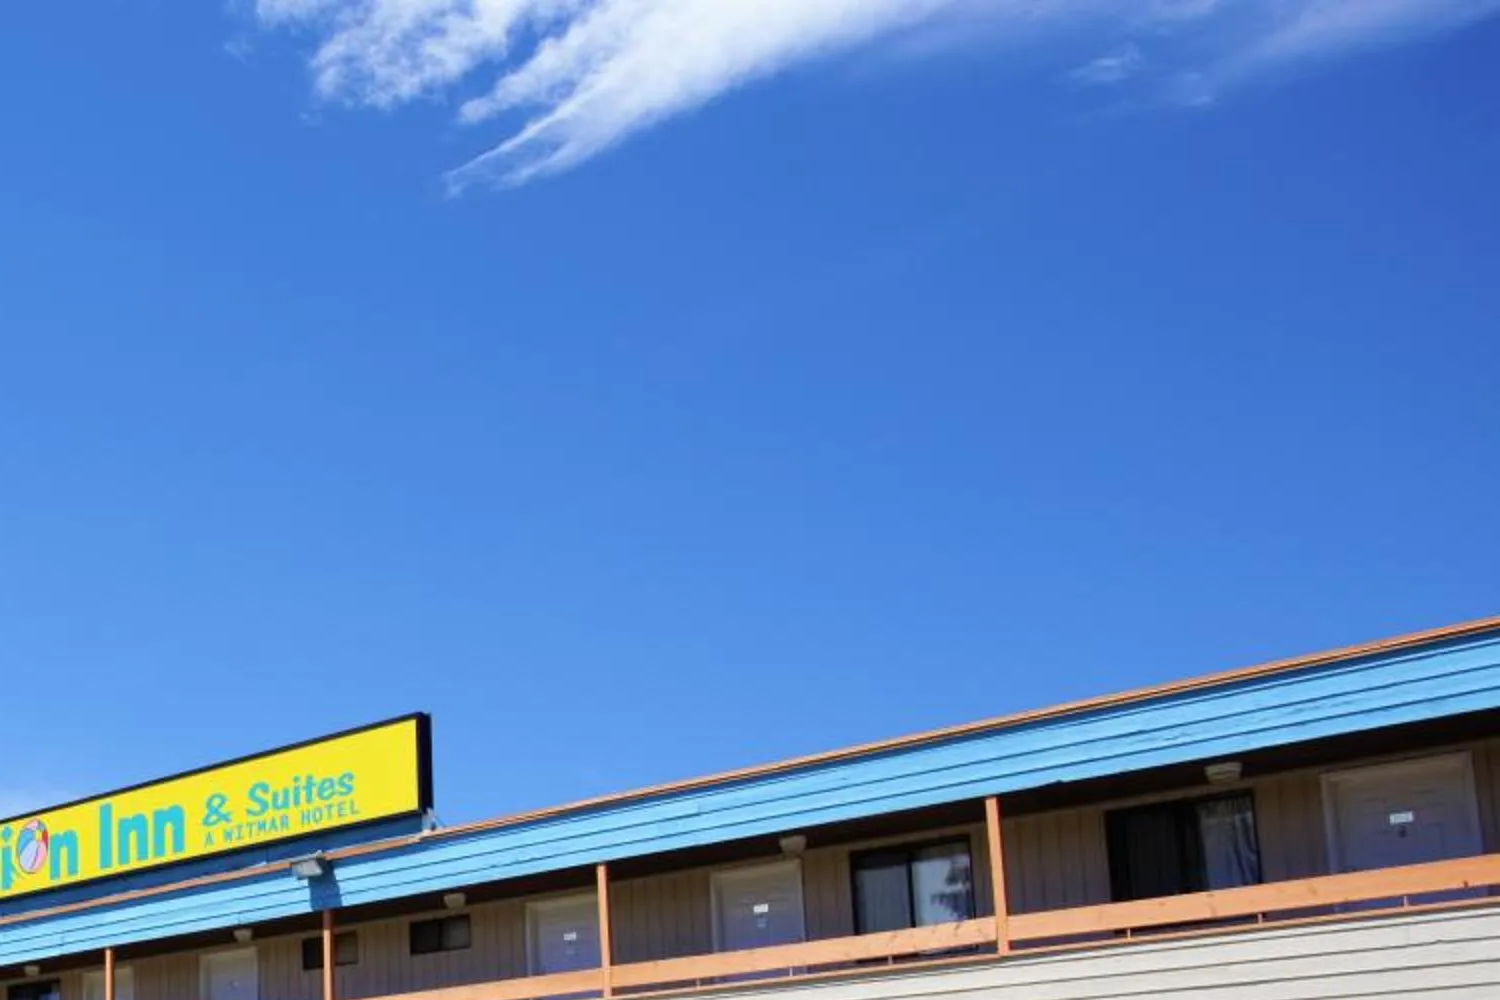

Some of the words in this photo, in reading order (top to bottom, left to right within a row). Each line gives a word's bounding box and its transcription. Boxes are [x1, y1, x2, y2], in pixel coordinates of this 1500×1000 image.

[100, 803, 185, 868] Inn
[202, 793, 231, 827] &
[246, 772, 354, 816] Suites
[204, 832, 214, 847] A
[300, 800, 360, 827] HOTEL
